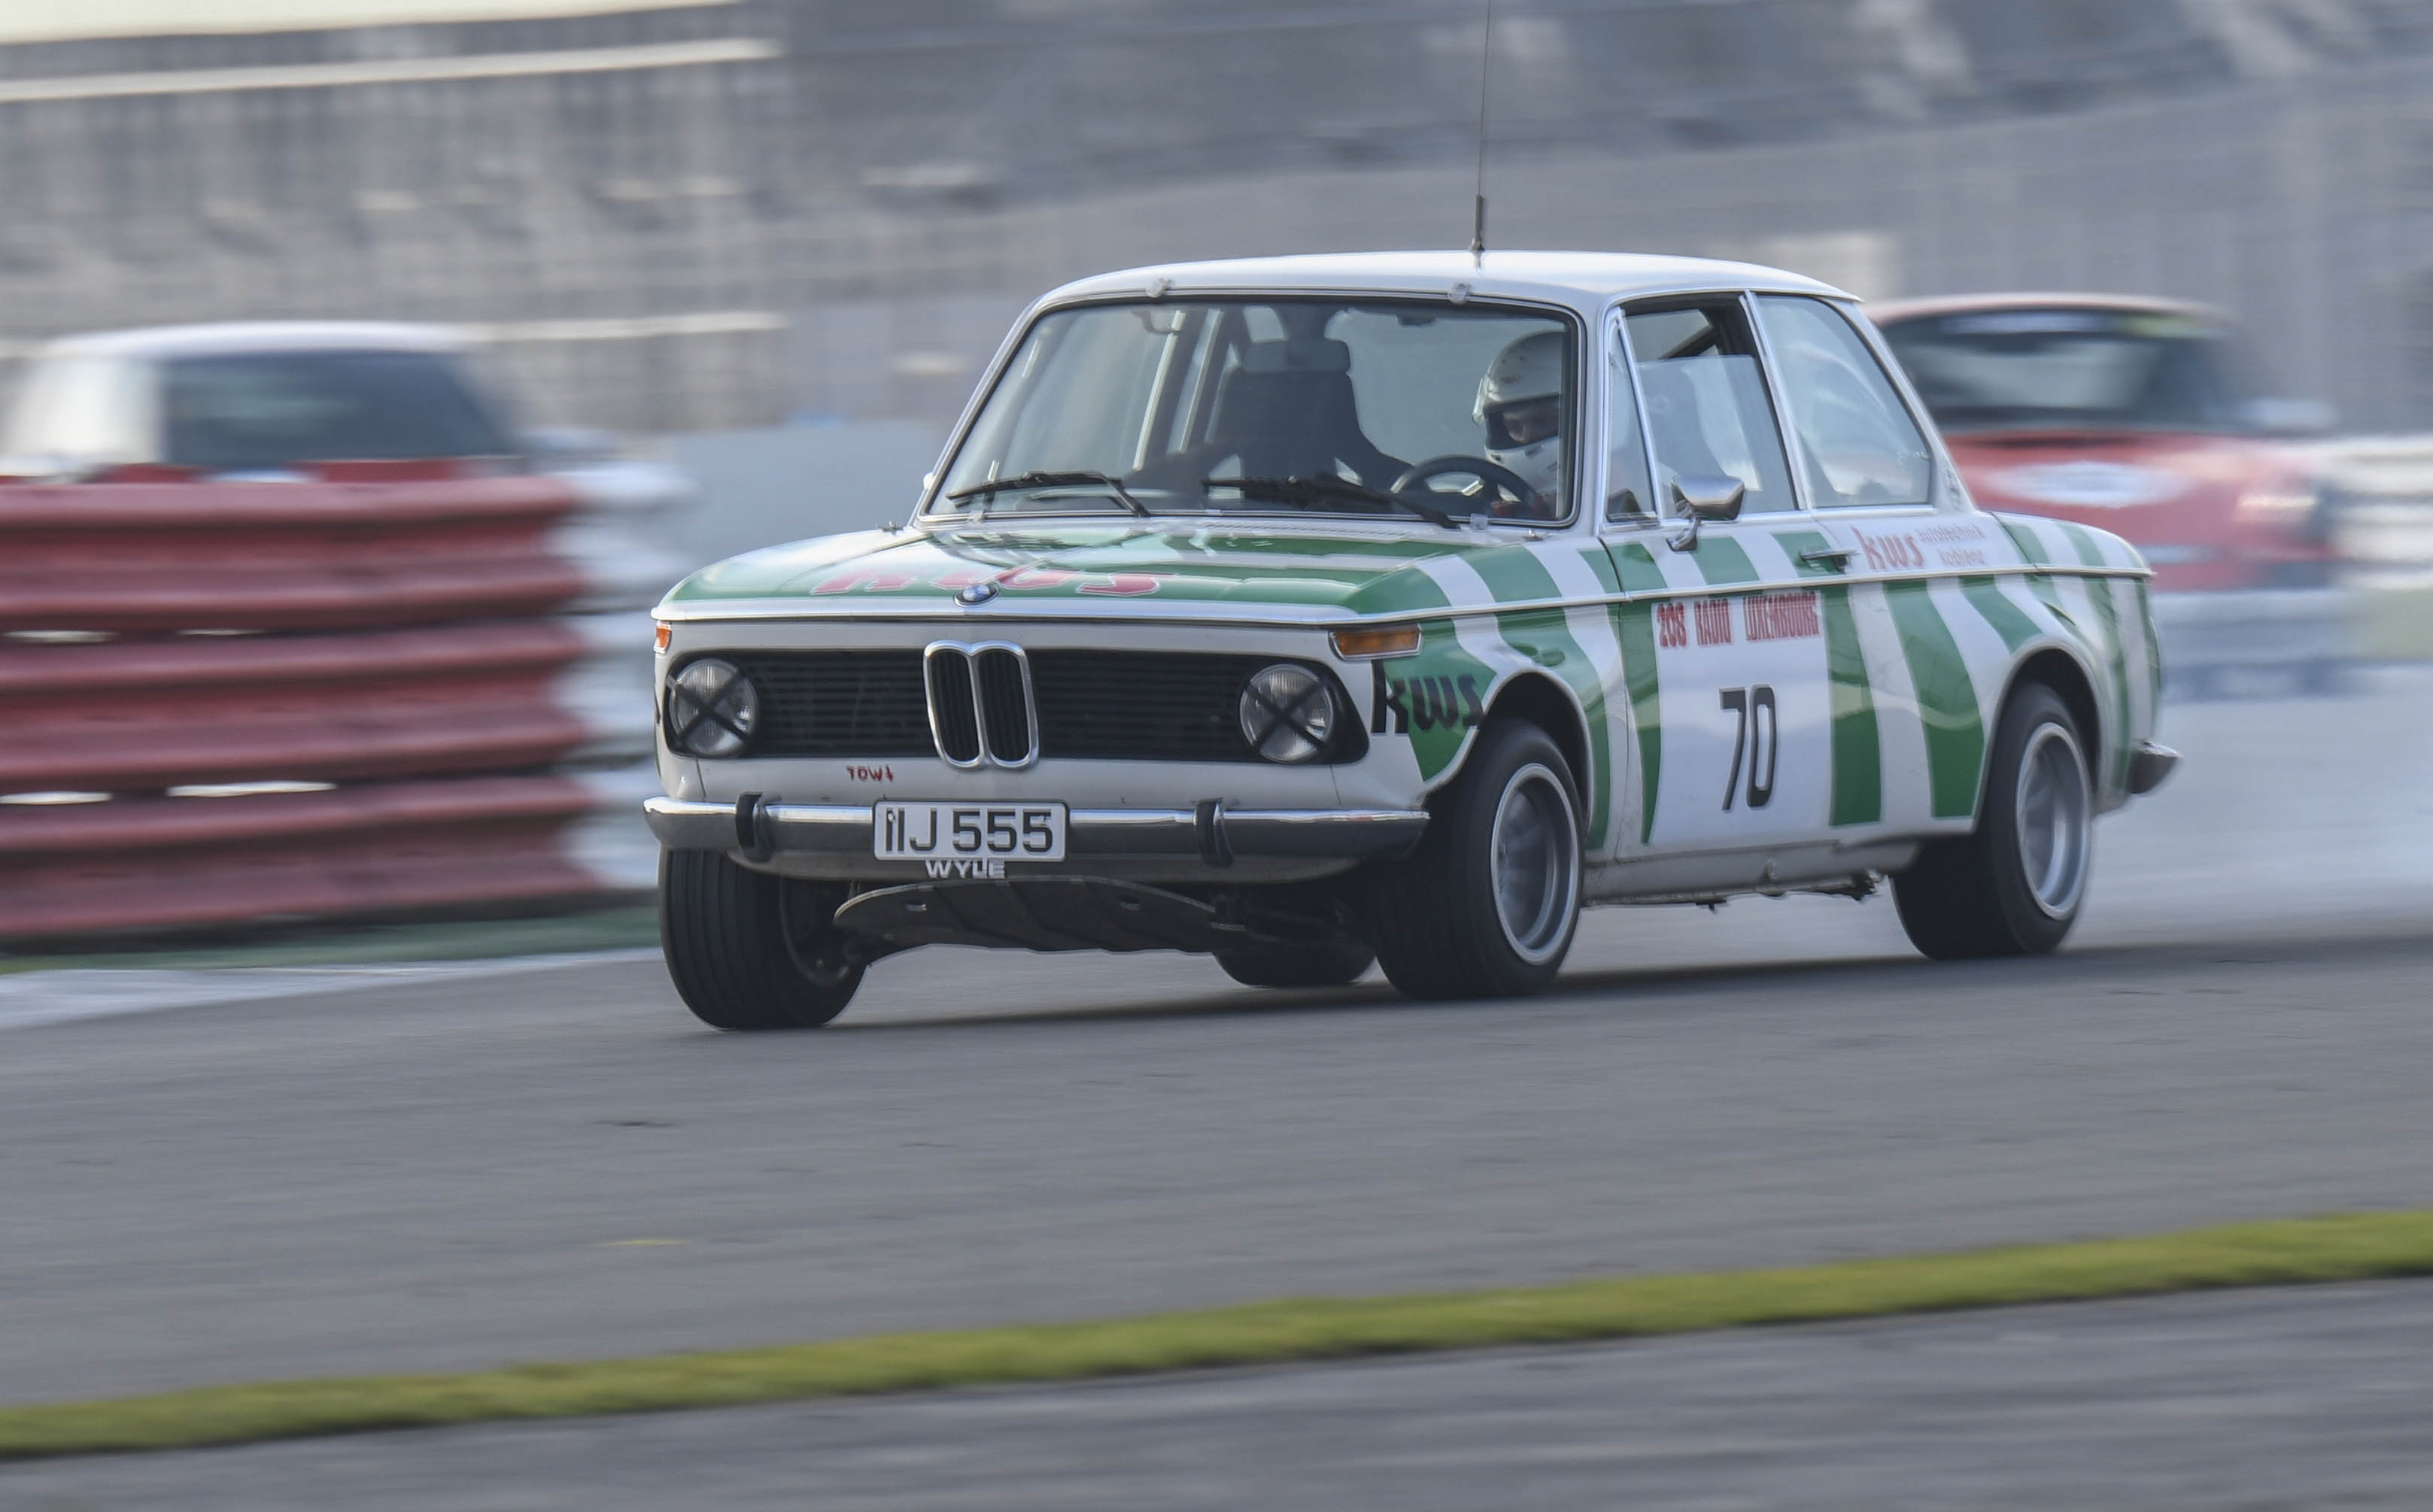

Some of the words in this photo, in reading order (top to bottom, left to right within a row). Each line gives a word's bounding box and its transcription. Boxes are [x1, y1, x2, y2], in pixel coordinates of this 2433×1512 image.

[1657, 603, 1687, 648] 208
[1693, 598, 1733, 645] RADIO
[1742, 591, 1819, 642] LUXEMBOURG
[846, 764, 882, 782] TOW
[1718, 685, 1776, 811] 70
[952, 808, 1053, 852] 555
